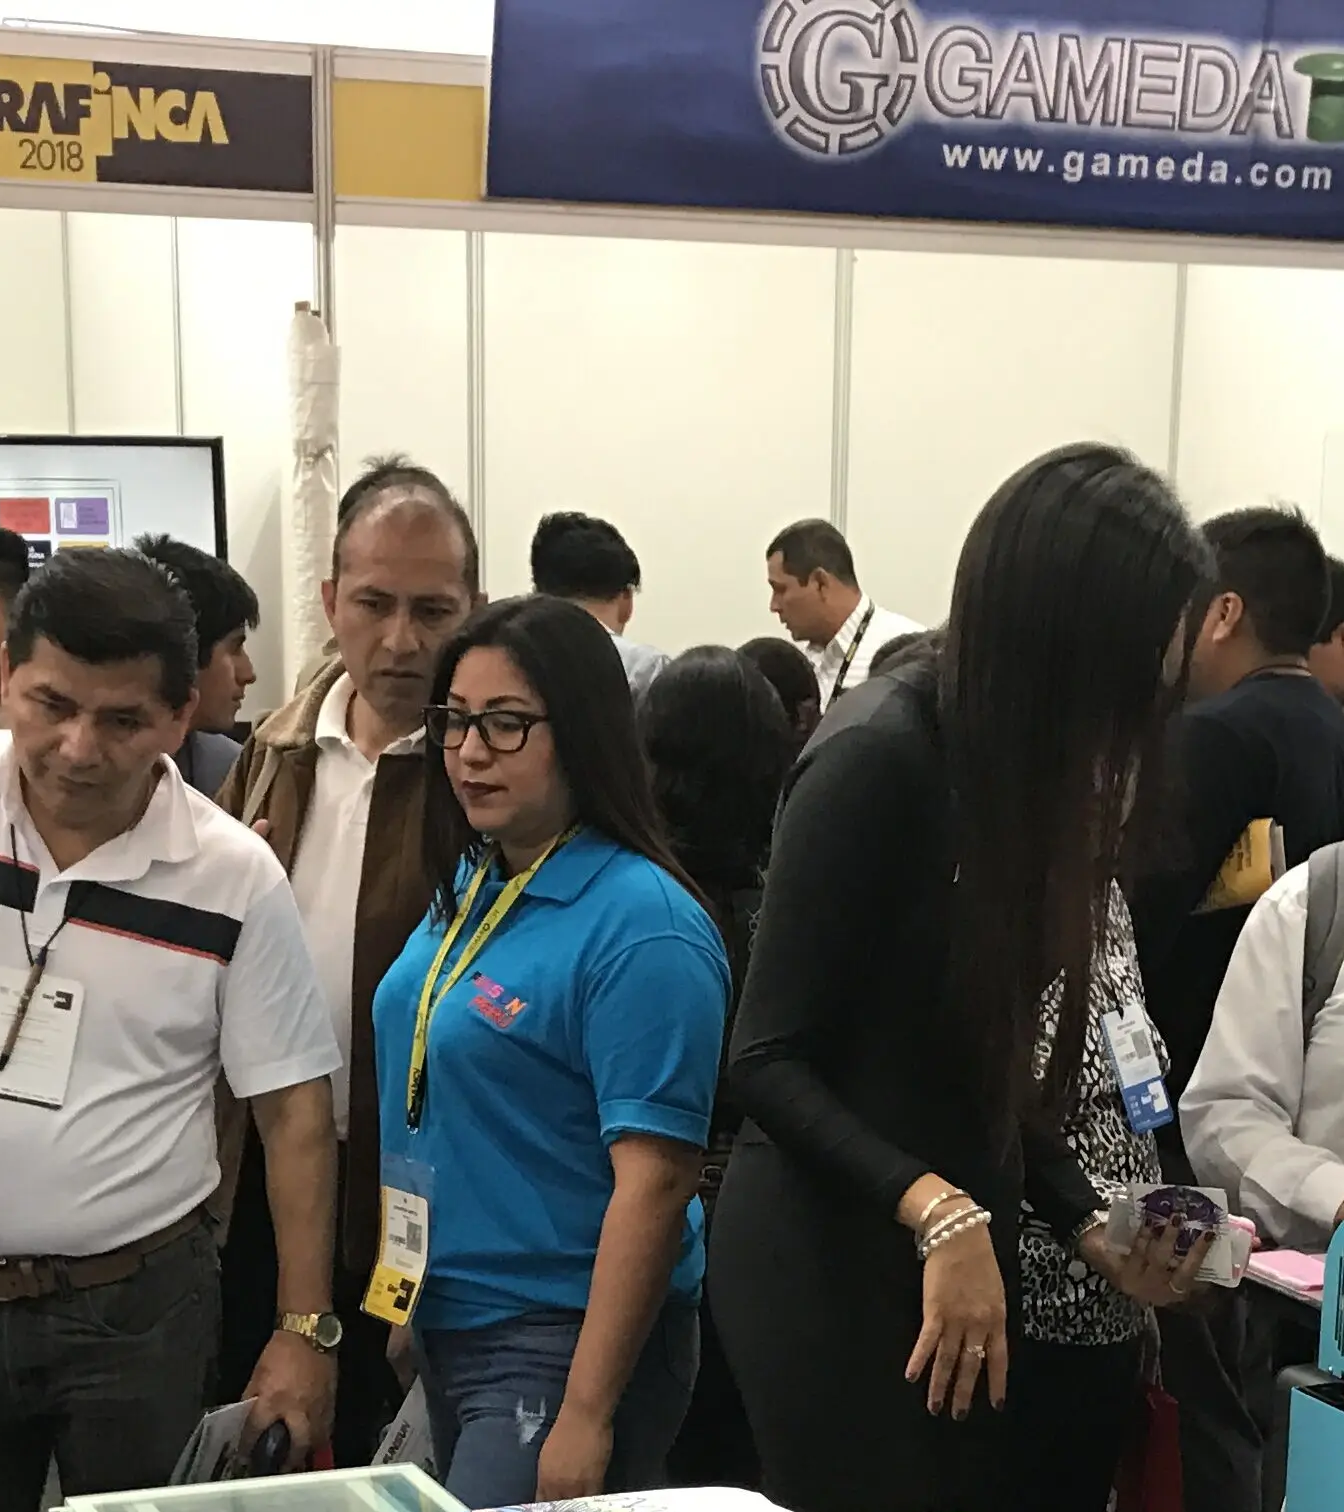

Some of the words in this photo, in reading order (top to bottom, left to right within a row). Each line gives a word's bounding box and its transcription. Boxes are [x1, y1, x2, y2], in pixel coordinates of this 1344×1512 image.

[924, 25, 1294, 139] GAMEDA
[19, 138, 84, 172] 2018
[942, 143, 1333, 191] www.gameda.com
